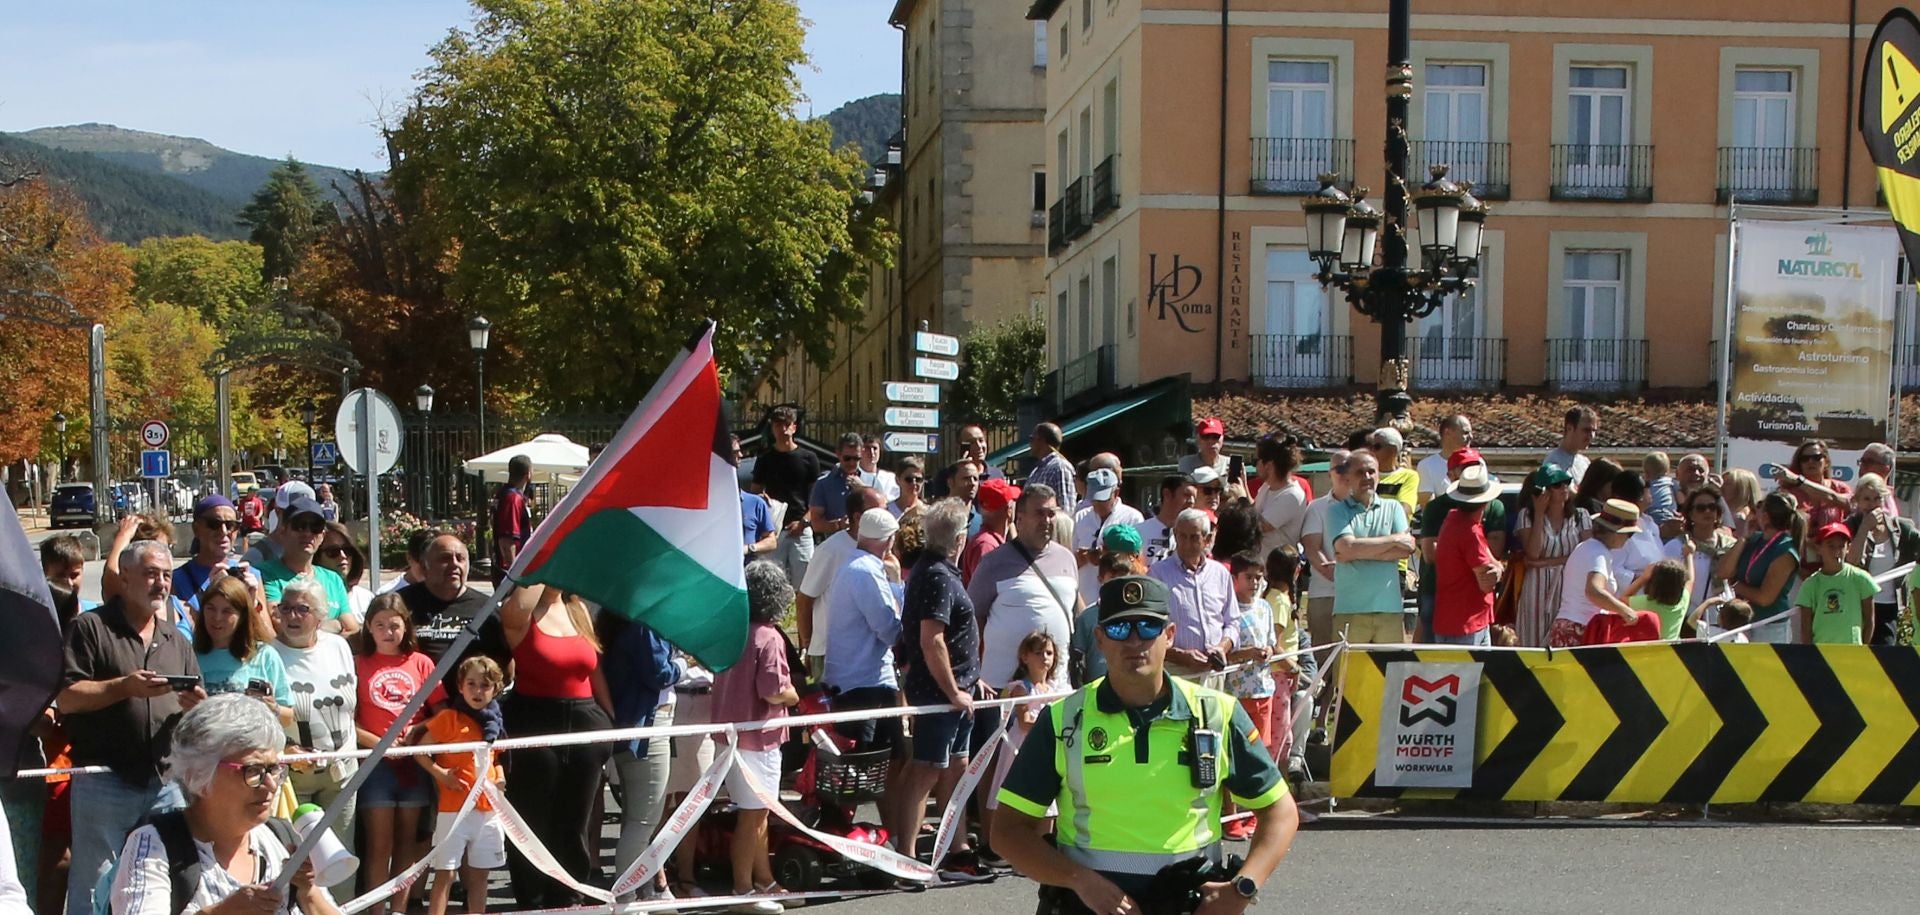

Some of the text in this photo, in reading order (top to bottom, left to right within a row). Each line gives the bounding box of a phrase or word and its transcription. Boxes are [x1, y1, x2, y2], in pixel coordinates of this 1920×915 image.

[1778, 259, 1863, 278] NATURCYL
[1230, 231, 1242, 349] RESTAURANTE
[1787, 320, 1819, 332] Charlas
[1820, 325, 1827, 333] y
[1798, 351, 1869, 364] Astroturismo
[1807, 365, 1828, 375] local
[1738, 392, 1795, 404] Actividades
[1758, 420, 1819, 431] Turismo Rural
[1396, 747, 1454, 757] MODYF
[1395, 764, 1453, 772] WORKWEAR
